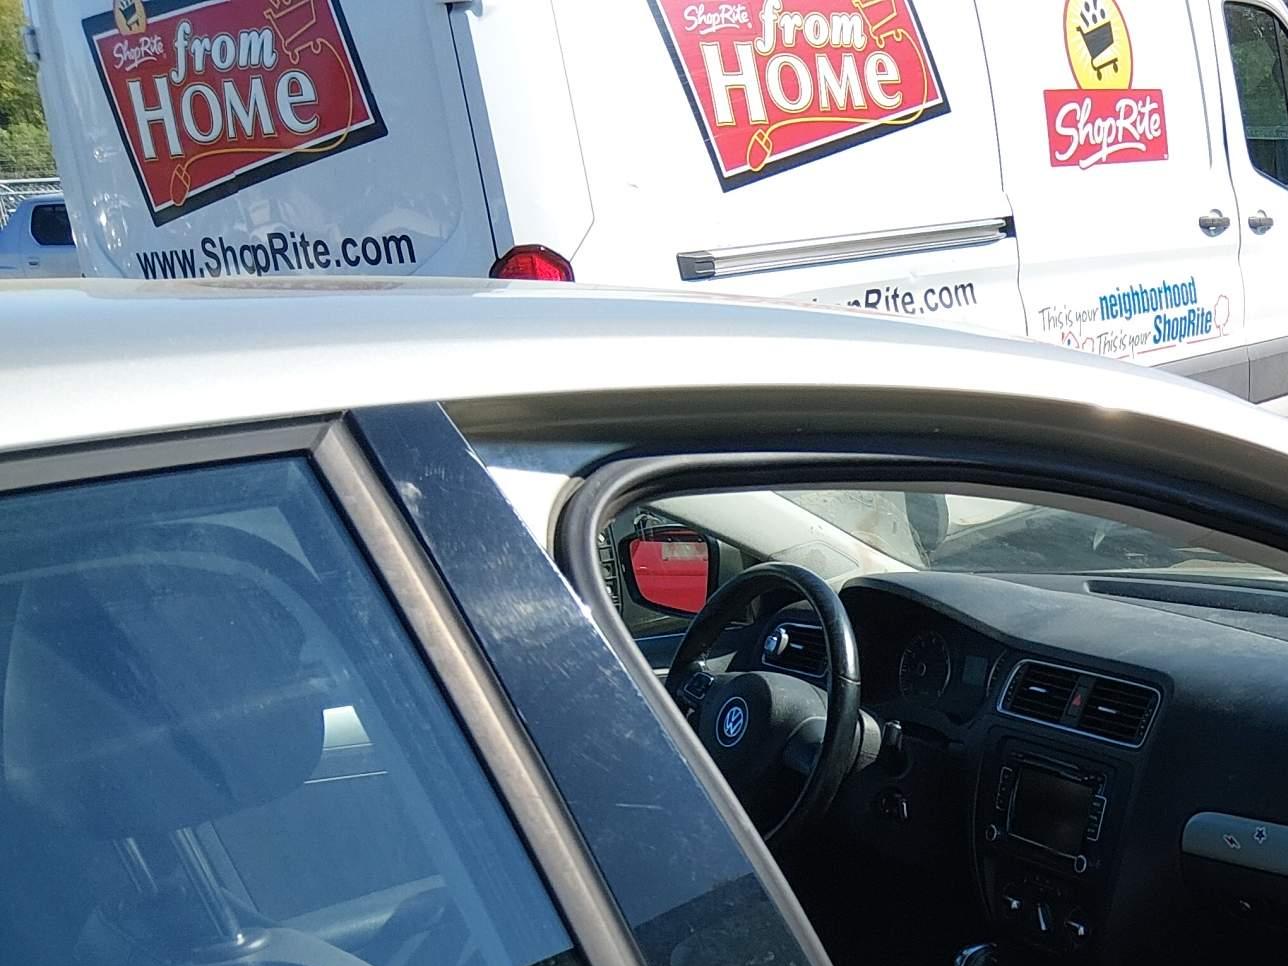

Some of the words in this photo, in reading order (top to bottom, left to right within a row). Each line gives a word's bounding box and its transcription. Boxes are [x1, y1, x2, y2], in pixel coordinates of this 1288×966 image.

[684, 4, 750, 34] ShopRite
[754, 0, 866, 56] from
[113, 35, 164, 71] ShopRite
[169, 19, 277, 86] from
[1055, 96, 1162, 170] ShopRite
[136, 232, 416, 280] www.ShopRite.com
[812, 282, 978, 315] Rite.com
[1038, 305, 1063, 332] This
[1075, 307, 1099, 337] your
[1099, 276, 1198, 321] neighborhood
[1152, 308, 1213, 344] ShopRite
